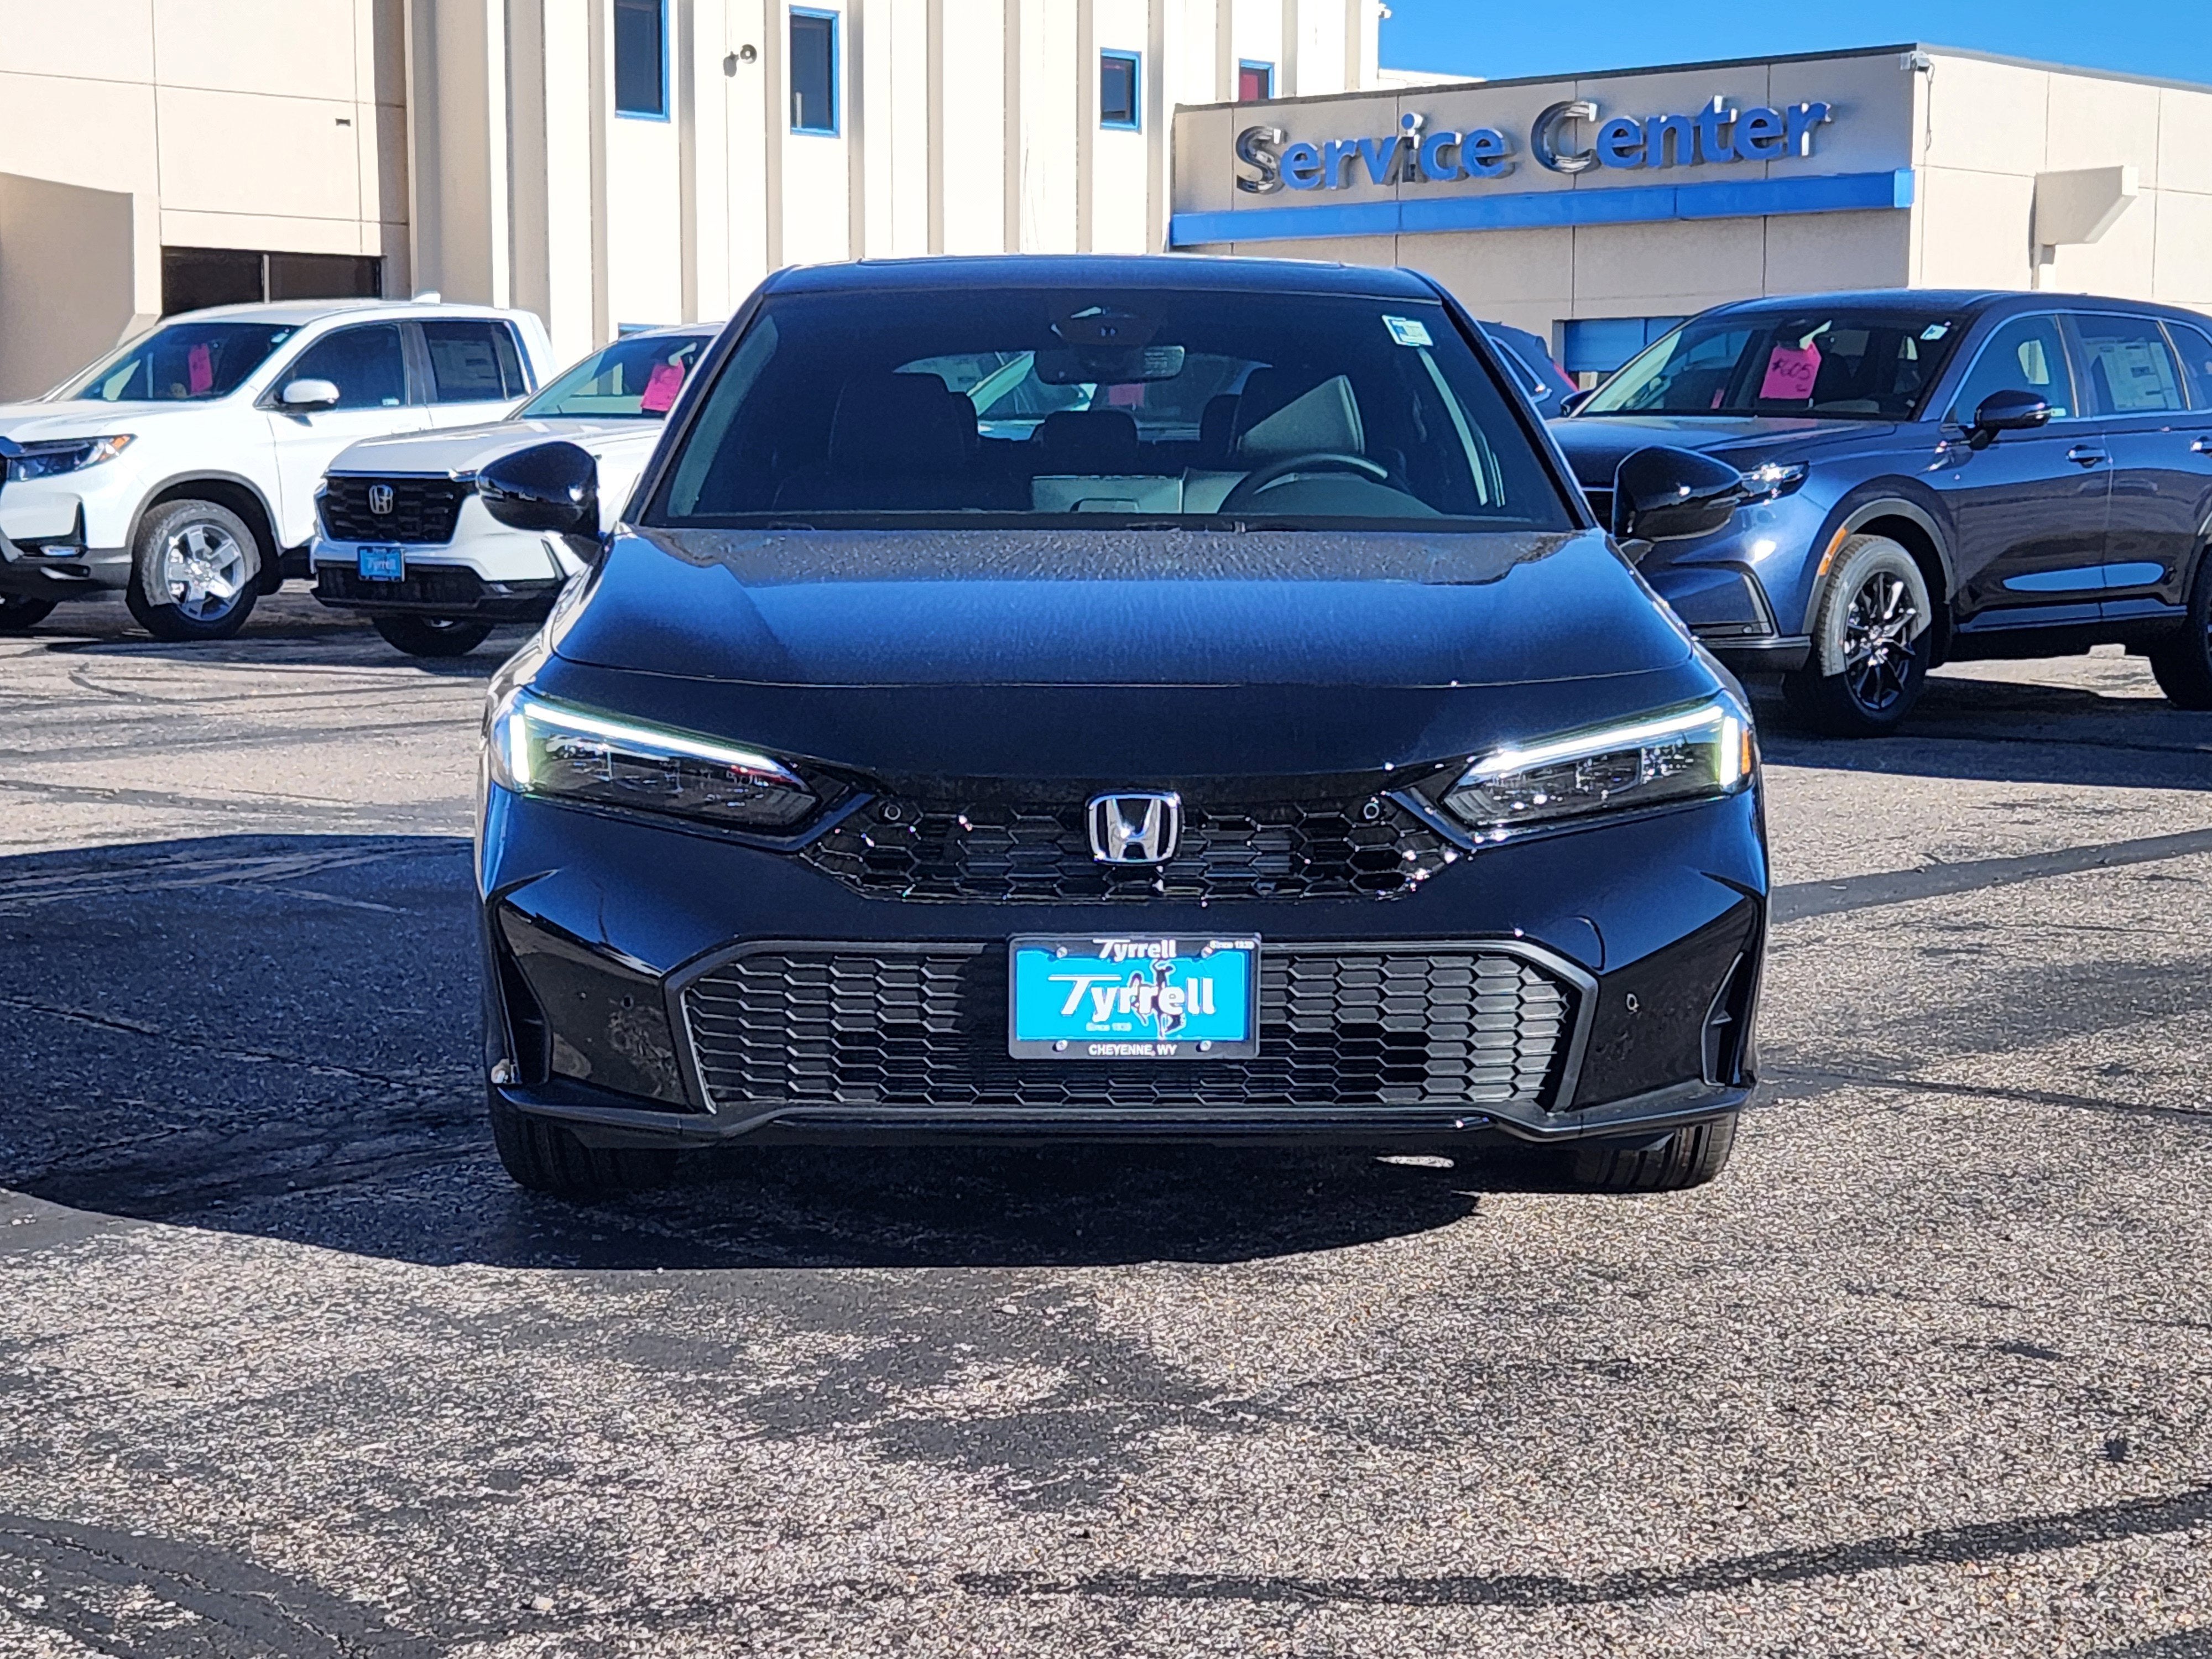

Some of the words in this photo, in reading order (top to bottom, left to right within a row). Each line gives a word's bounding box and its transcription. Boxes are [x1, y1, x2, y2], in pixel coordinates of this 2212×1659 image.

[1235, 112, 1510, 194] Service
[1530, 95, 1831, 173] Center
[1093, 939, 1177, 962] Tyrrell
[1048, 974, 1216, 1022] Tyrrell
[1088, 1044, 1156, 1056] CHEYENNE,
[1156, 1044, 1178, 1056] WY
